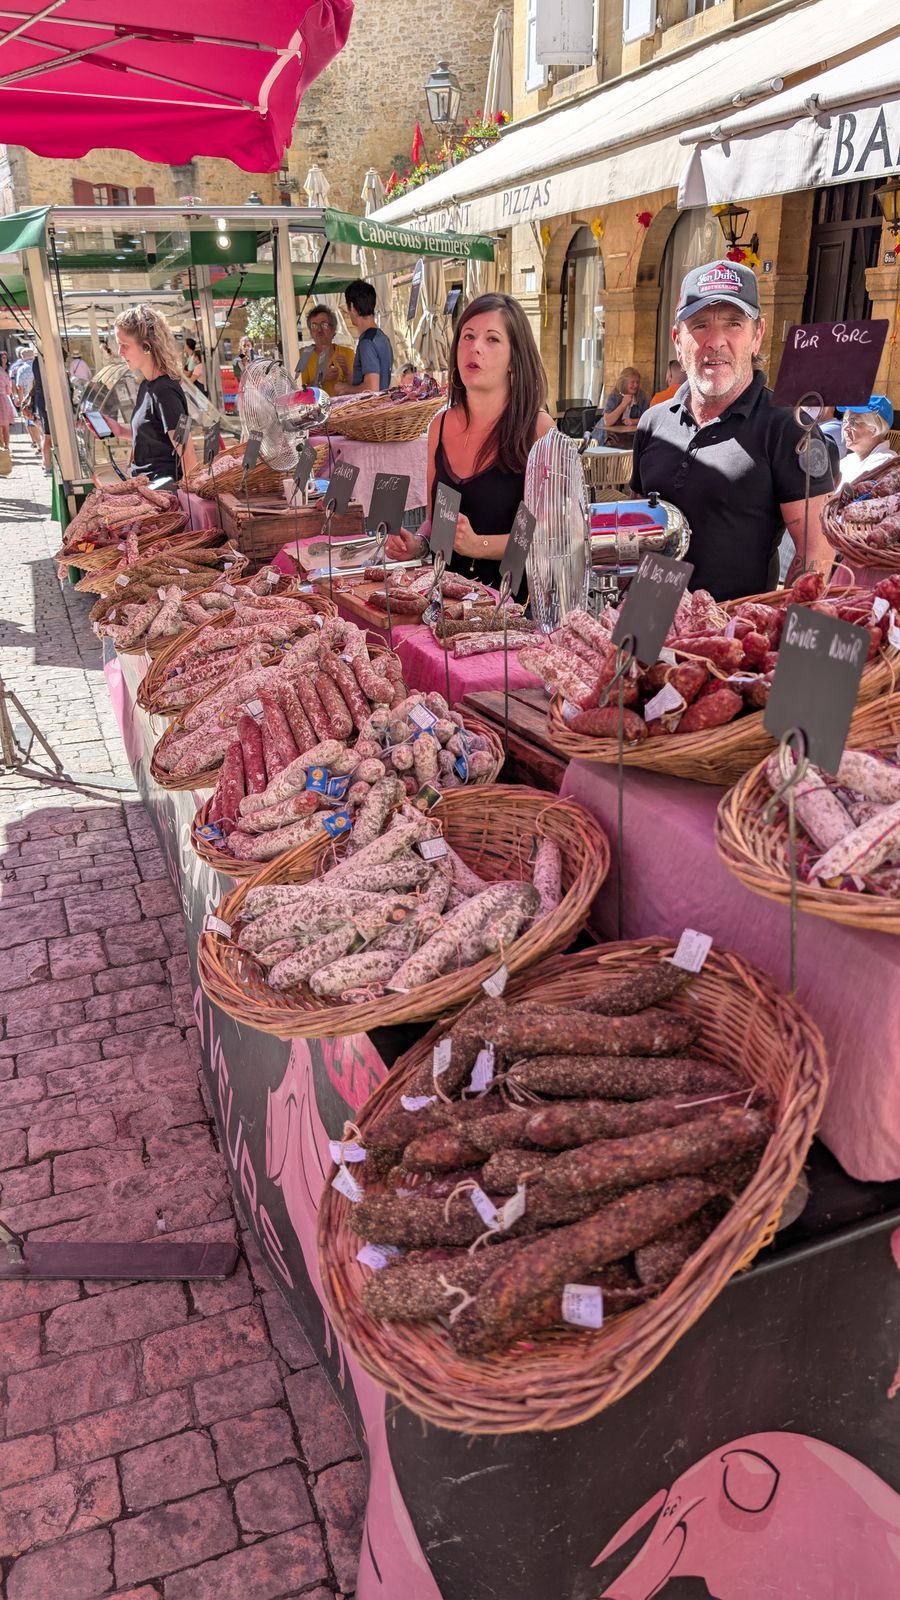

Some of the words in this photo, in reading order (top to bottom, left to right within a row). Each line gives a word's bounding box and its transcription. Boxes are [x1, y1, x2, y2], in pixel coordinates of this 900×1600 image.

[832, 104, 900, 177] BA
[502, 179, 552, 217] PIZZAS
[714, 268, 741, 284] Dutch
